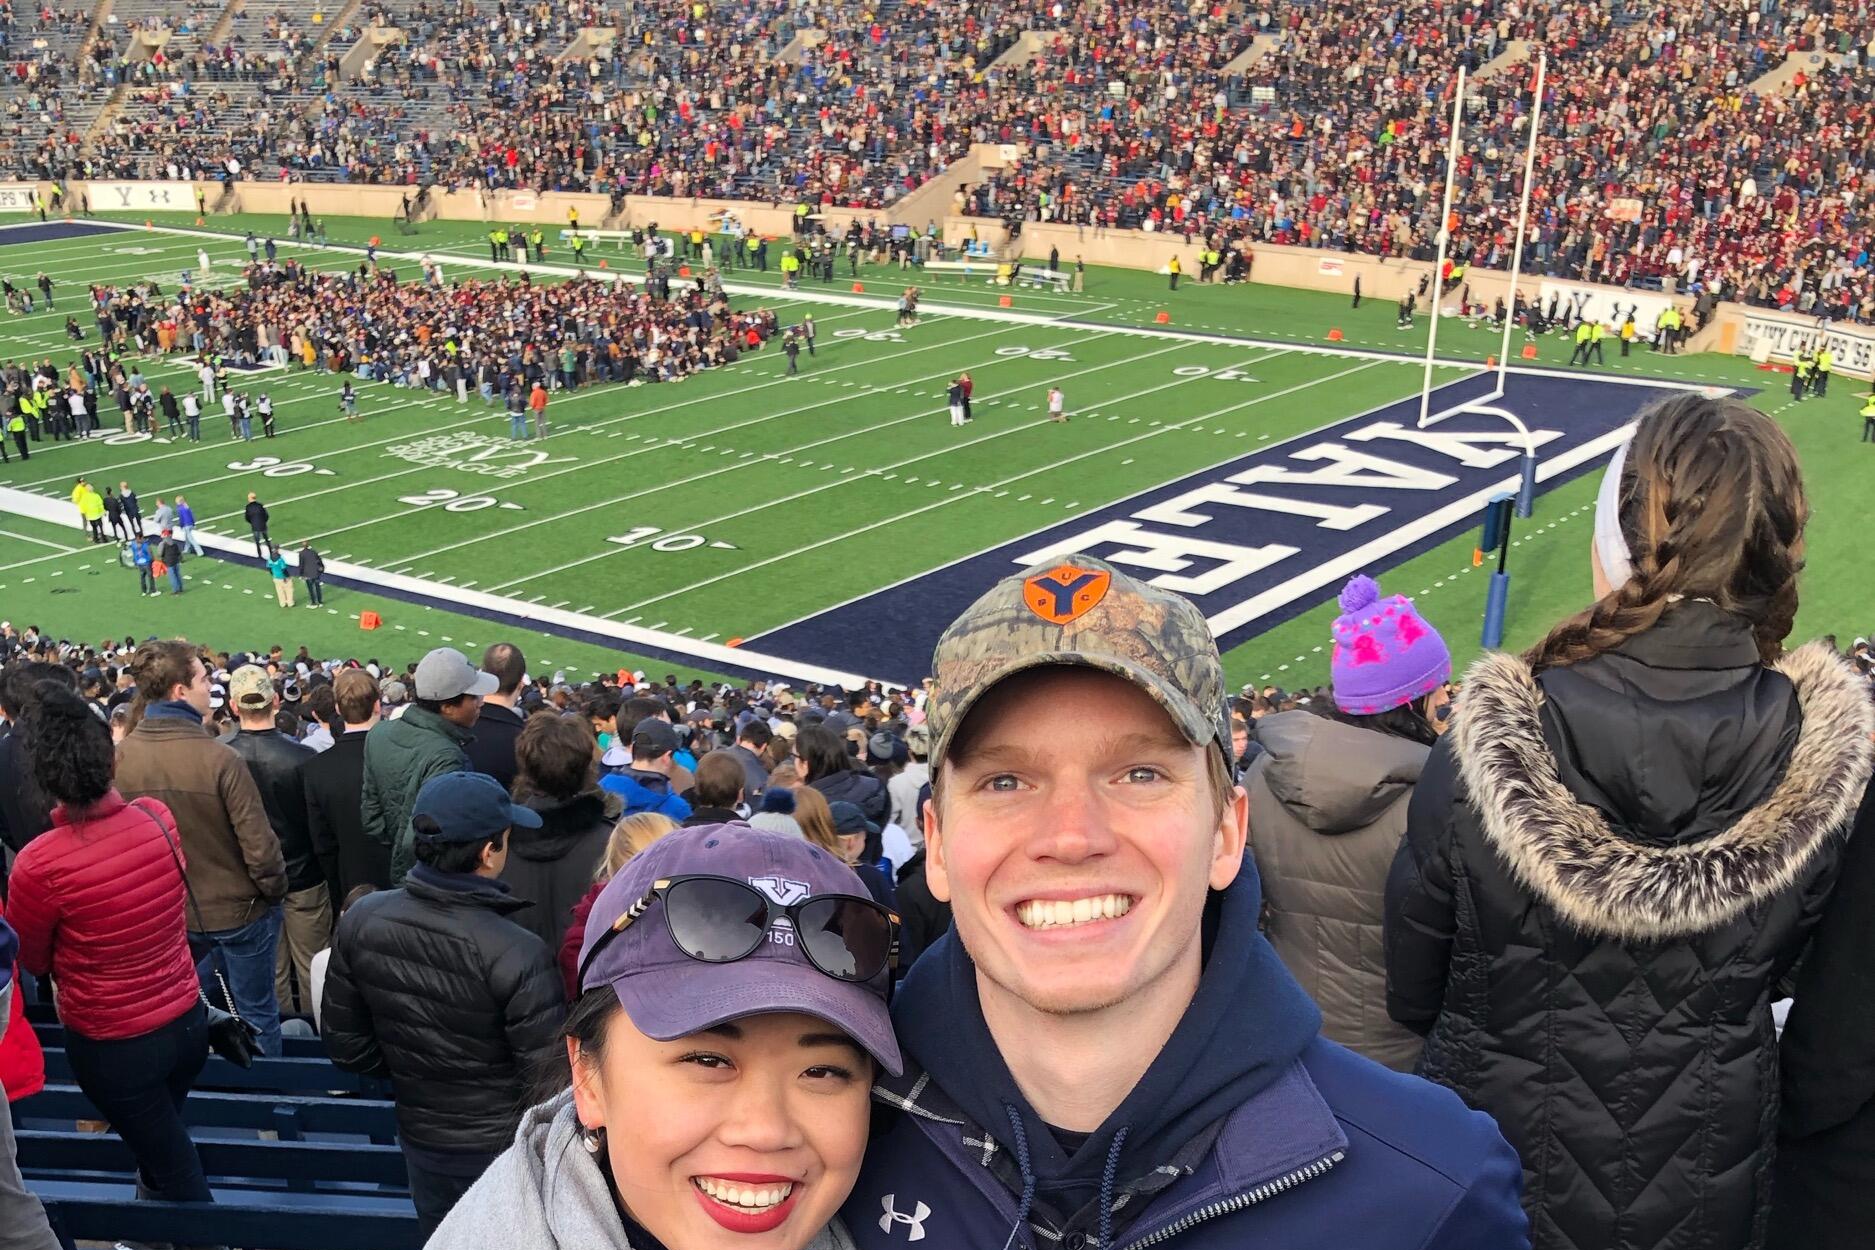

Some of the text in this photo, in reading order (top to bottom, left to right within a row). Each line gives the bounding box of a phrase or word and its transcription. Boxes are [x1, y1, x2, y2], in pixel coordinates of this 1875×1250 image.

[113, 187, 131, 206] Y
[225, 456, 315, 477] 30
[396, 488, 499, 512] 20
[1011, 421, 1567, 596] YALE
[604, 526, 706, 552] 10
[1061, 572, 1072, 581] U
[1030, 573, 1104, 618] Y
[767, 930, 795, 946] 150
